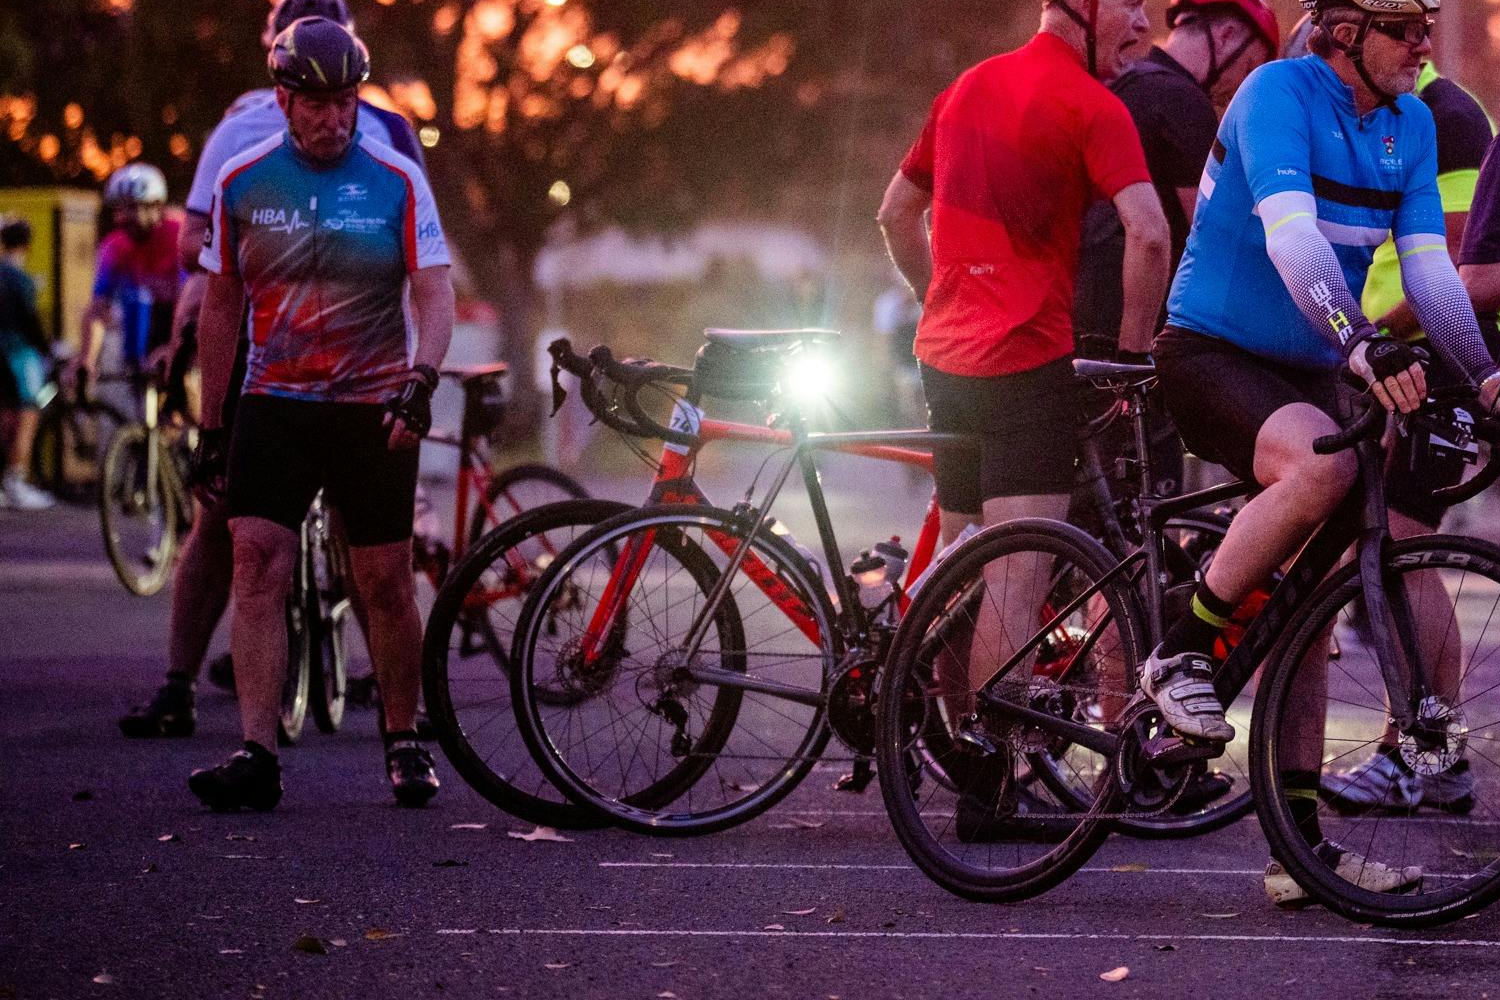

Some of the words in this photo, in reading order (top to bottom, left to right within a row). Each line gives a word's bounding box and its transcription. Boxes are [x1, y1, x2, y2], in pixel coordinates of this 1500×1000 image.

[1362, 0, 1407, 10] RUDY
[1276, 168, 1297, 177] hub
[252, 208, 287, 225] HBA
